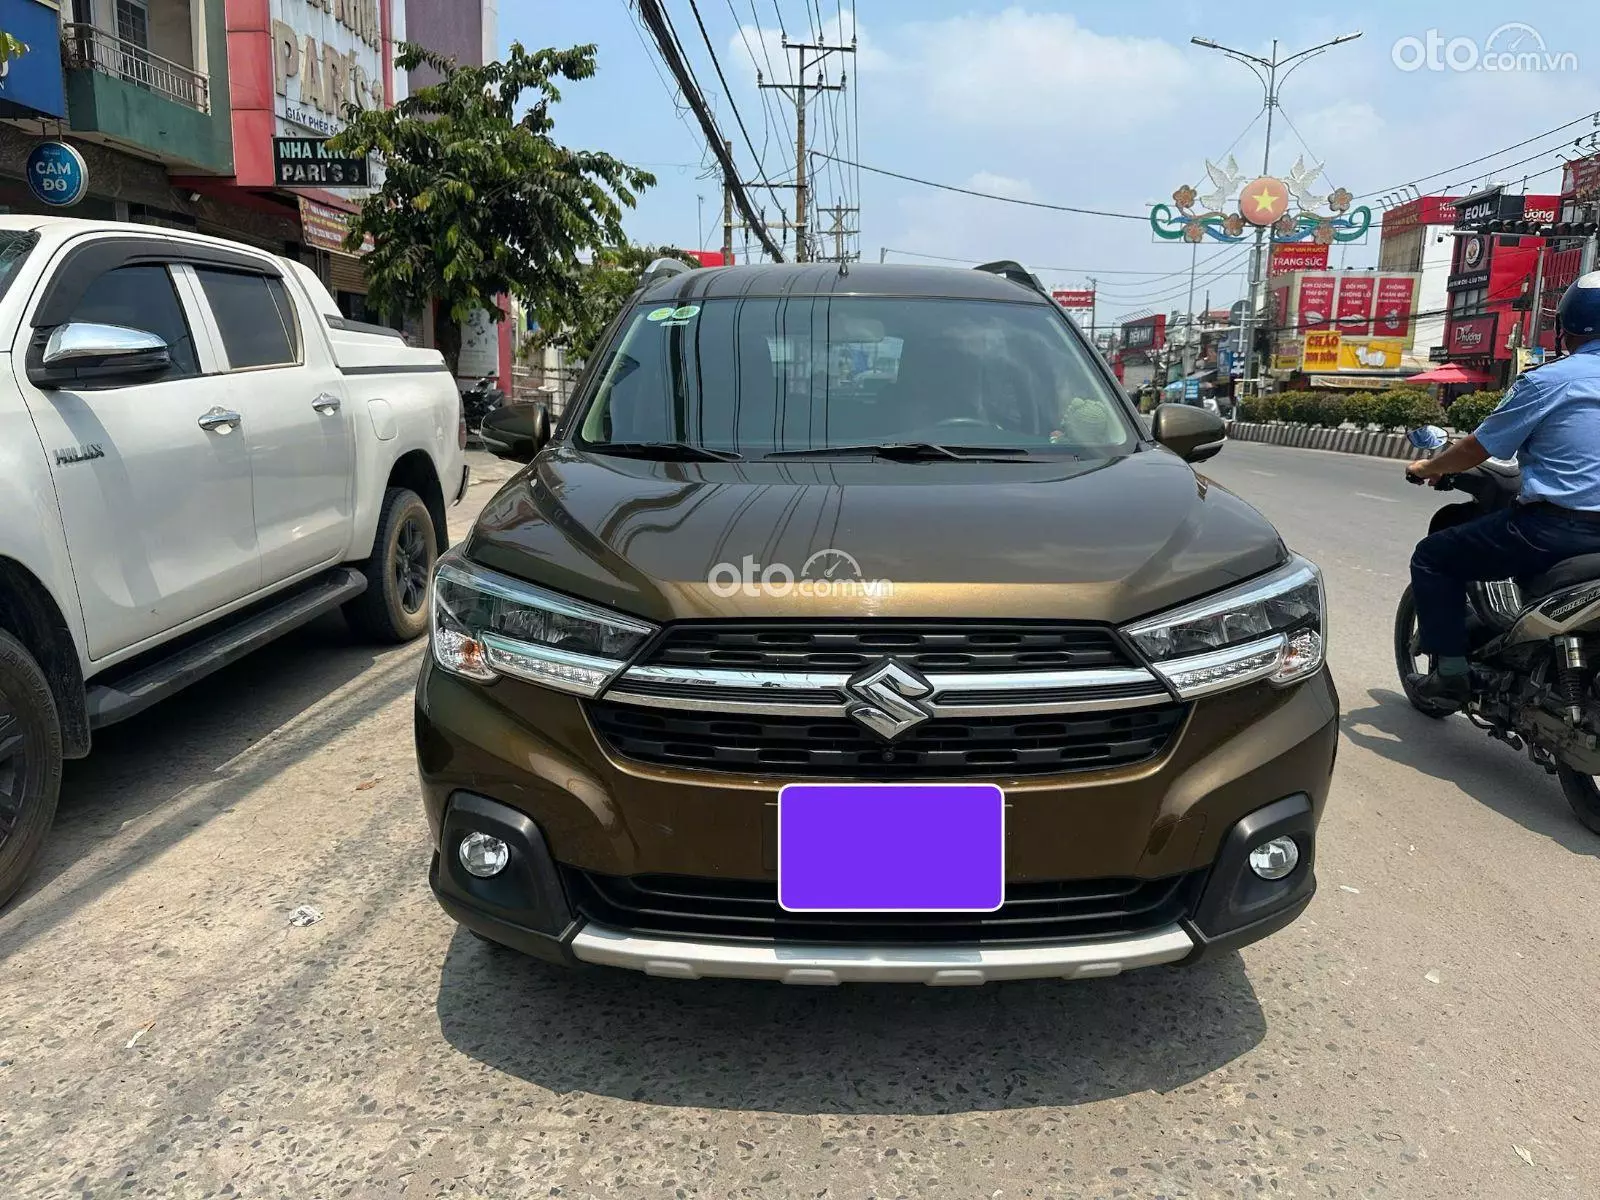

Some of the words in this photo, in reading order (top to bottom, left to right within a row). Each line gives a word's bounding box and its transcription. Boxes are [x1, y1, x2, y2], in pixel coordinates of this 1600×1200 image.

[279, 141, 313, 159] NHA
[282, 162, 344, 182] PARI'S
[1274, 257, 1303, 266] TRANG
